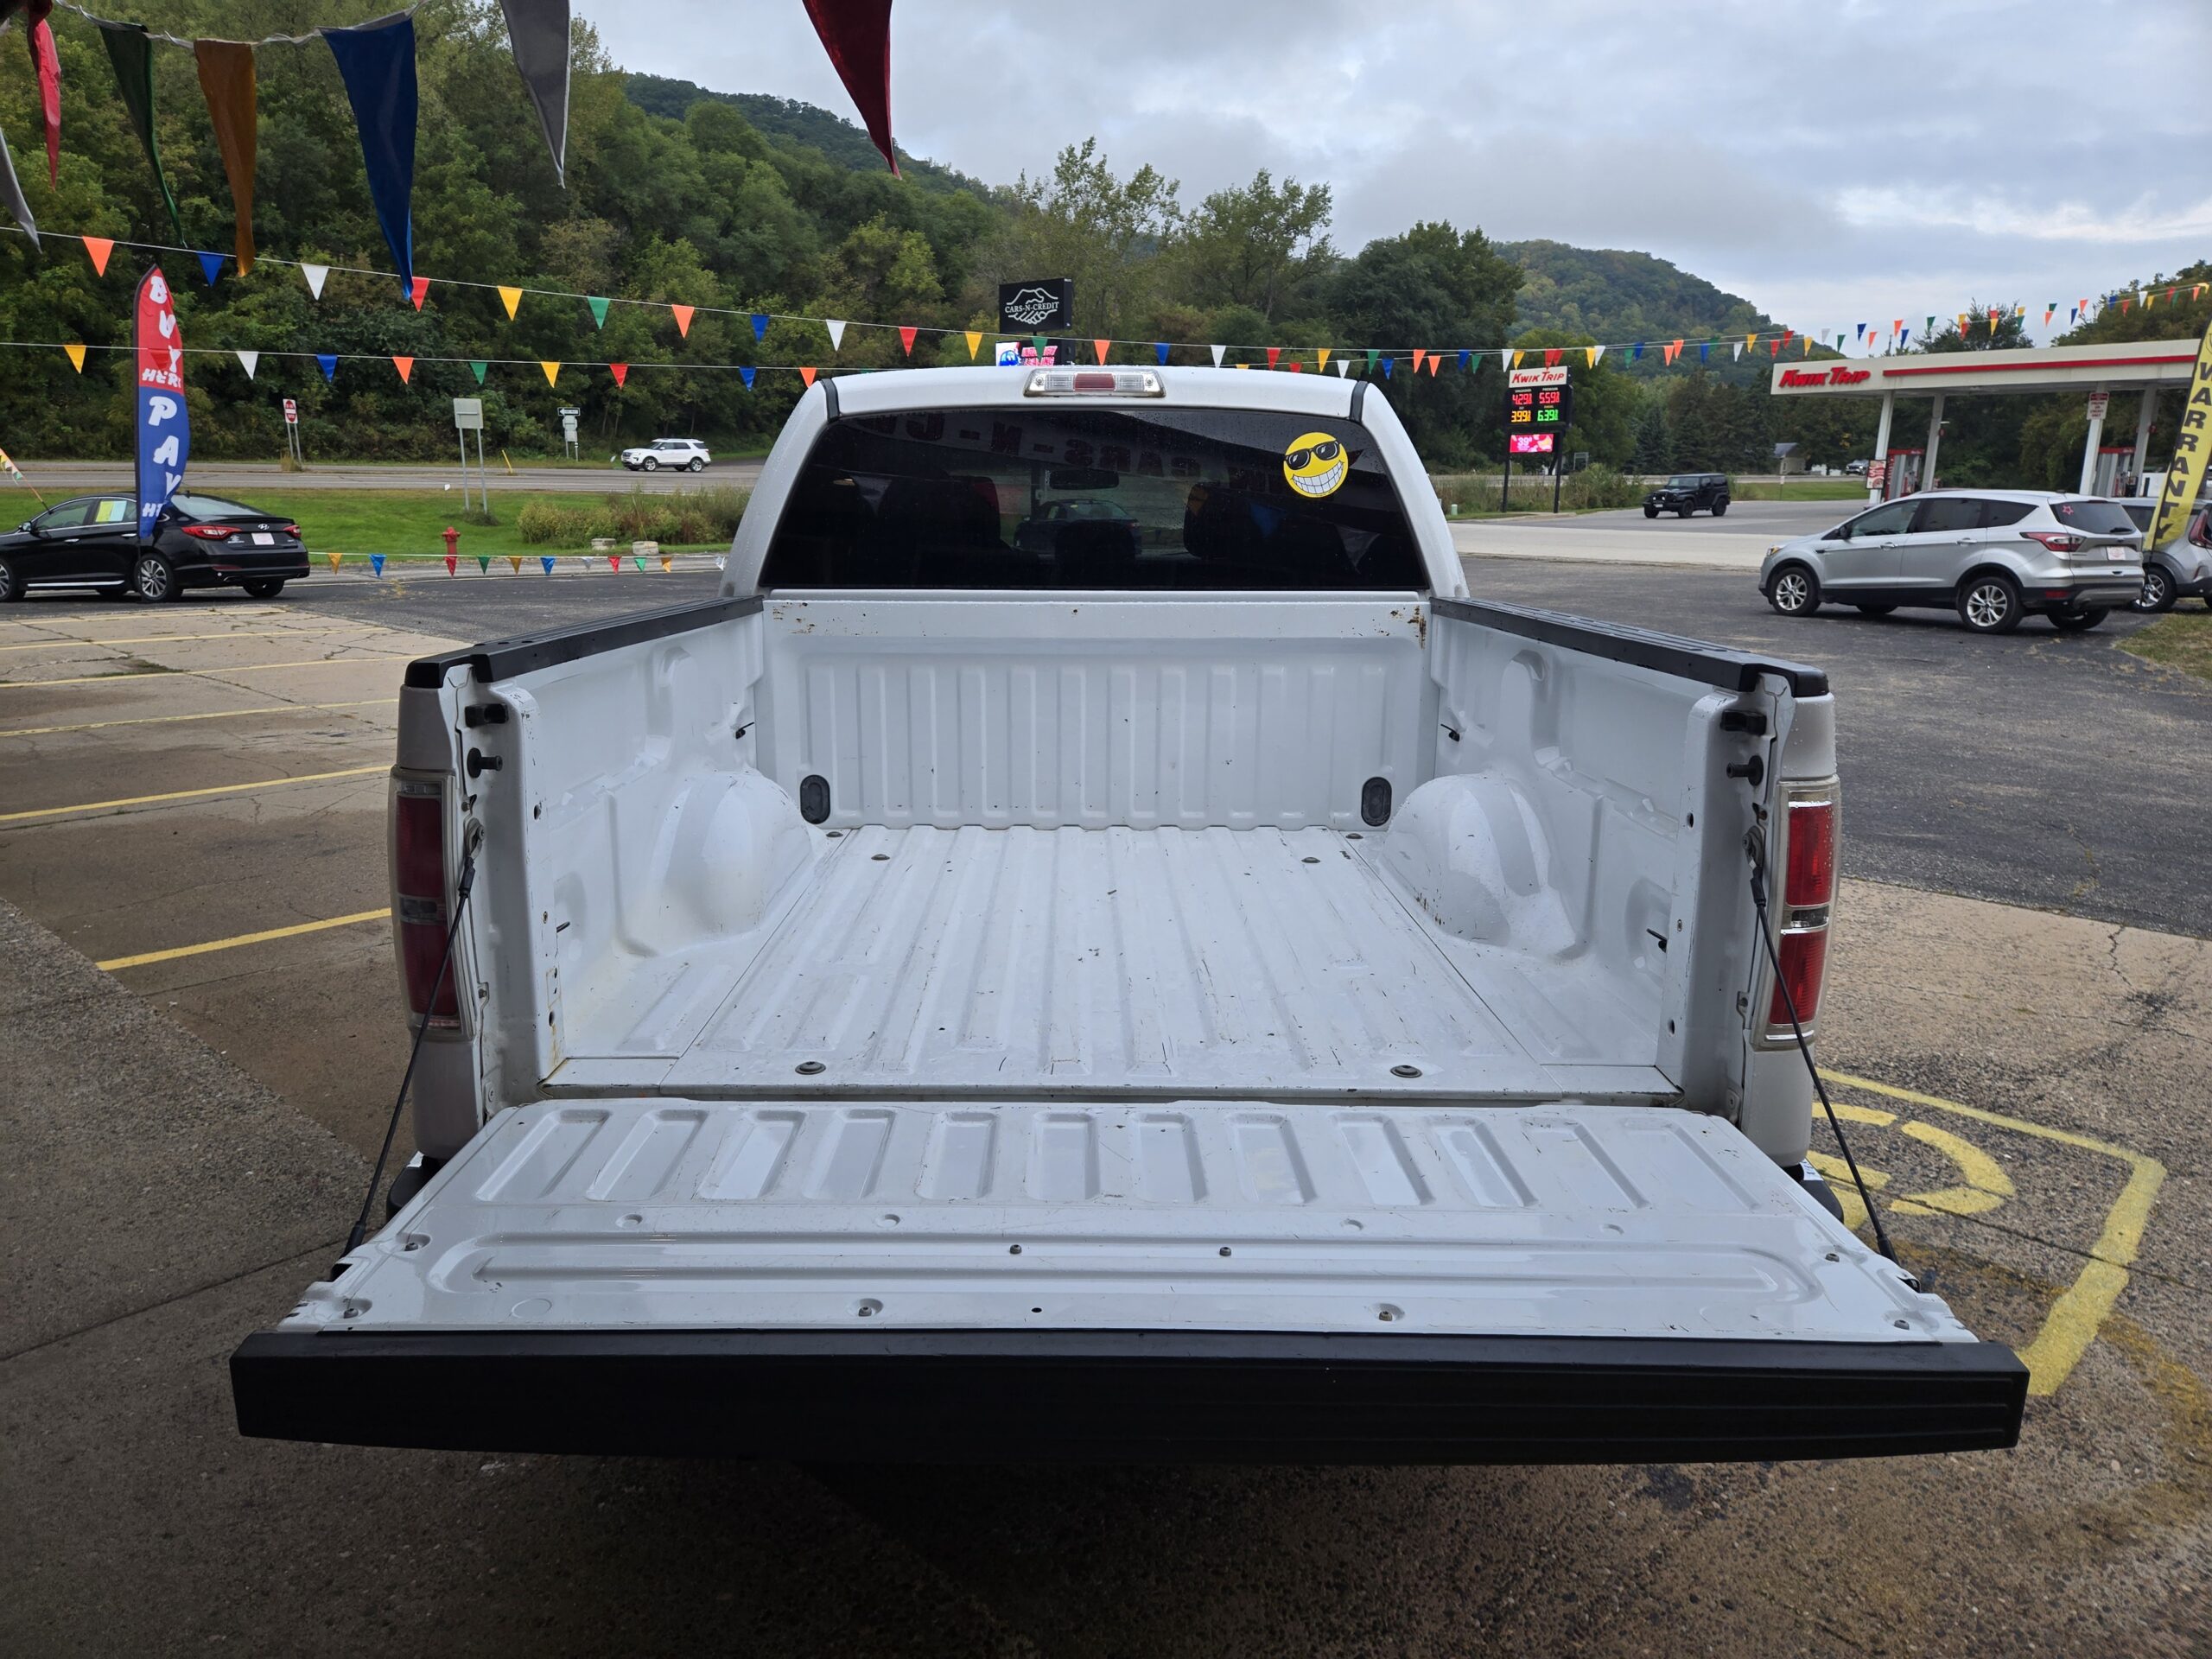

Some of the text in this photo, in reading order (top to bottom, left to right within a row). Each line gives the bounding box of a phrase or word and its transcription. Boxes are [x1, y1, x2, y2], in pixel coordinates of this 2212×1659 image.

[1005, 302, 1059, 313] CARS-N-CREDIT
[143, 368, 181, 389] HER
[1511, 372, 1565, 384] KWIK TRIP
[1829, 366, 1871, 385] TRIP
